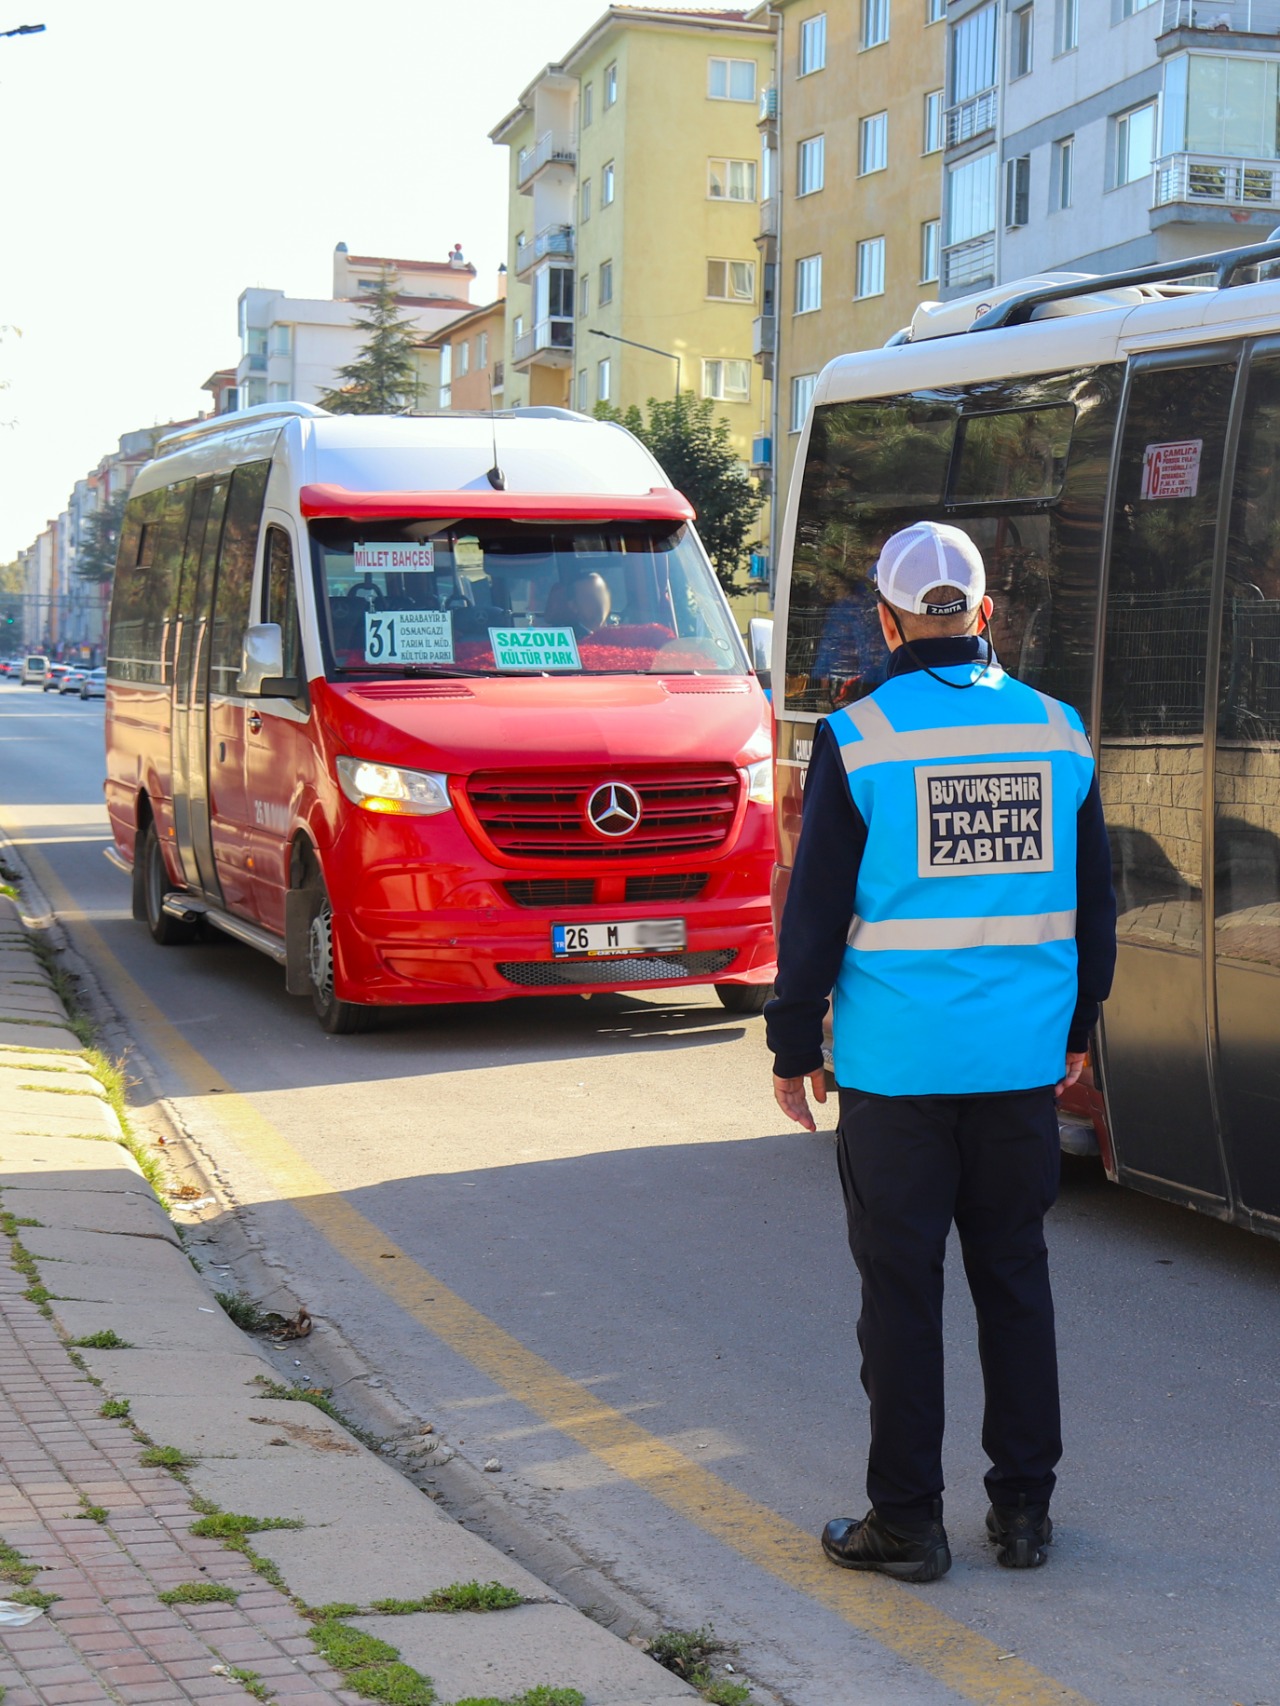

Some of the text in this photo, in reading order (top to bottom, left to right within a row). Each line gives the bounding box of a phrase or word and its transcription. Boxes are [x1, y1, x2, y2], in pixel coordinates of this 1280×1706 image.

[355, 546, 433, 570] MİLLET BAHÇESİ
[931, 604, 962, 614] ZABITA
[369, 618, 397, 658] 31
[496, 632, 570, 647] SAZOVA
[400, 650, 428, 661] KÜLTÜR
[500, 648, 575, 664] KÜLTÜR PARK
[930, 776, 1041, 808] BÜYÜKŞEHİR
[932, 808, 1040, 836] TRAFİK
[932, 836, 1041, 865] ZABITA
[555, 941, 565, 949] TR
[566, 928, 589, 949] 26
[607, 926, 619, 947] M
